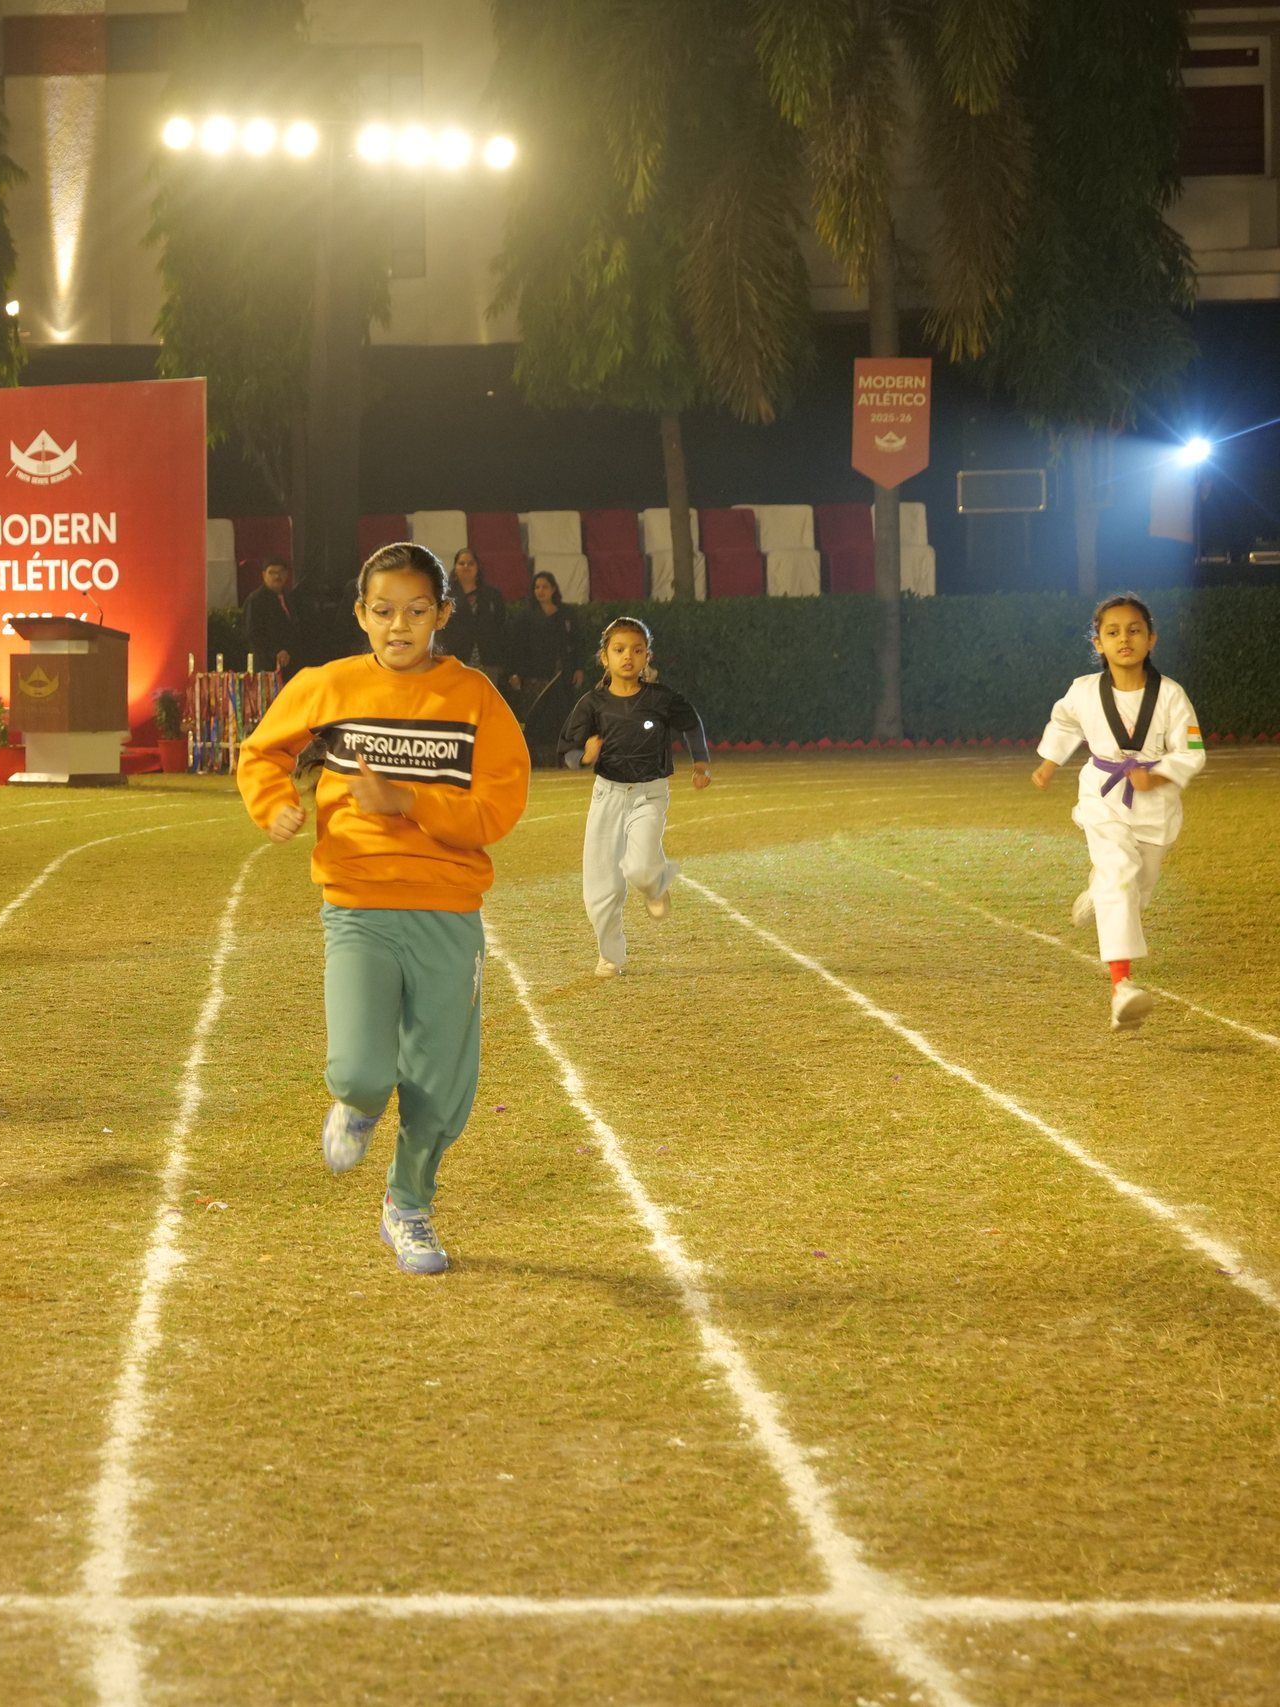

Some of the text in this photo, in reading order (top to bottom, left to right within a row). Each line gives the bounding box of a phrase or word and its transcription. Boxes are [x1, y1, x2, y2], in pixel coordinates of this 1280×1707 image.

[858, 375, 926, 389] MODERN
[858, 390, 926, 407] ATLÉTICO
[409, 758, 437, 768] TRAIL
